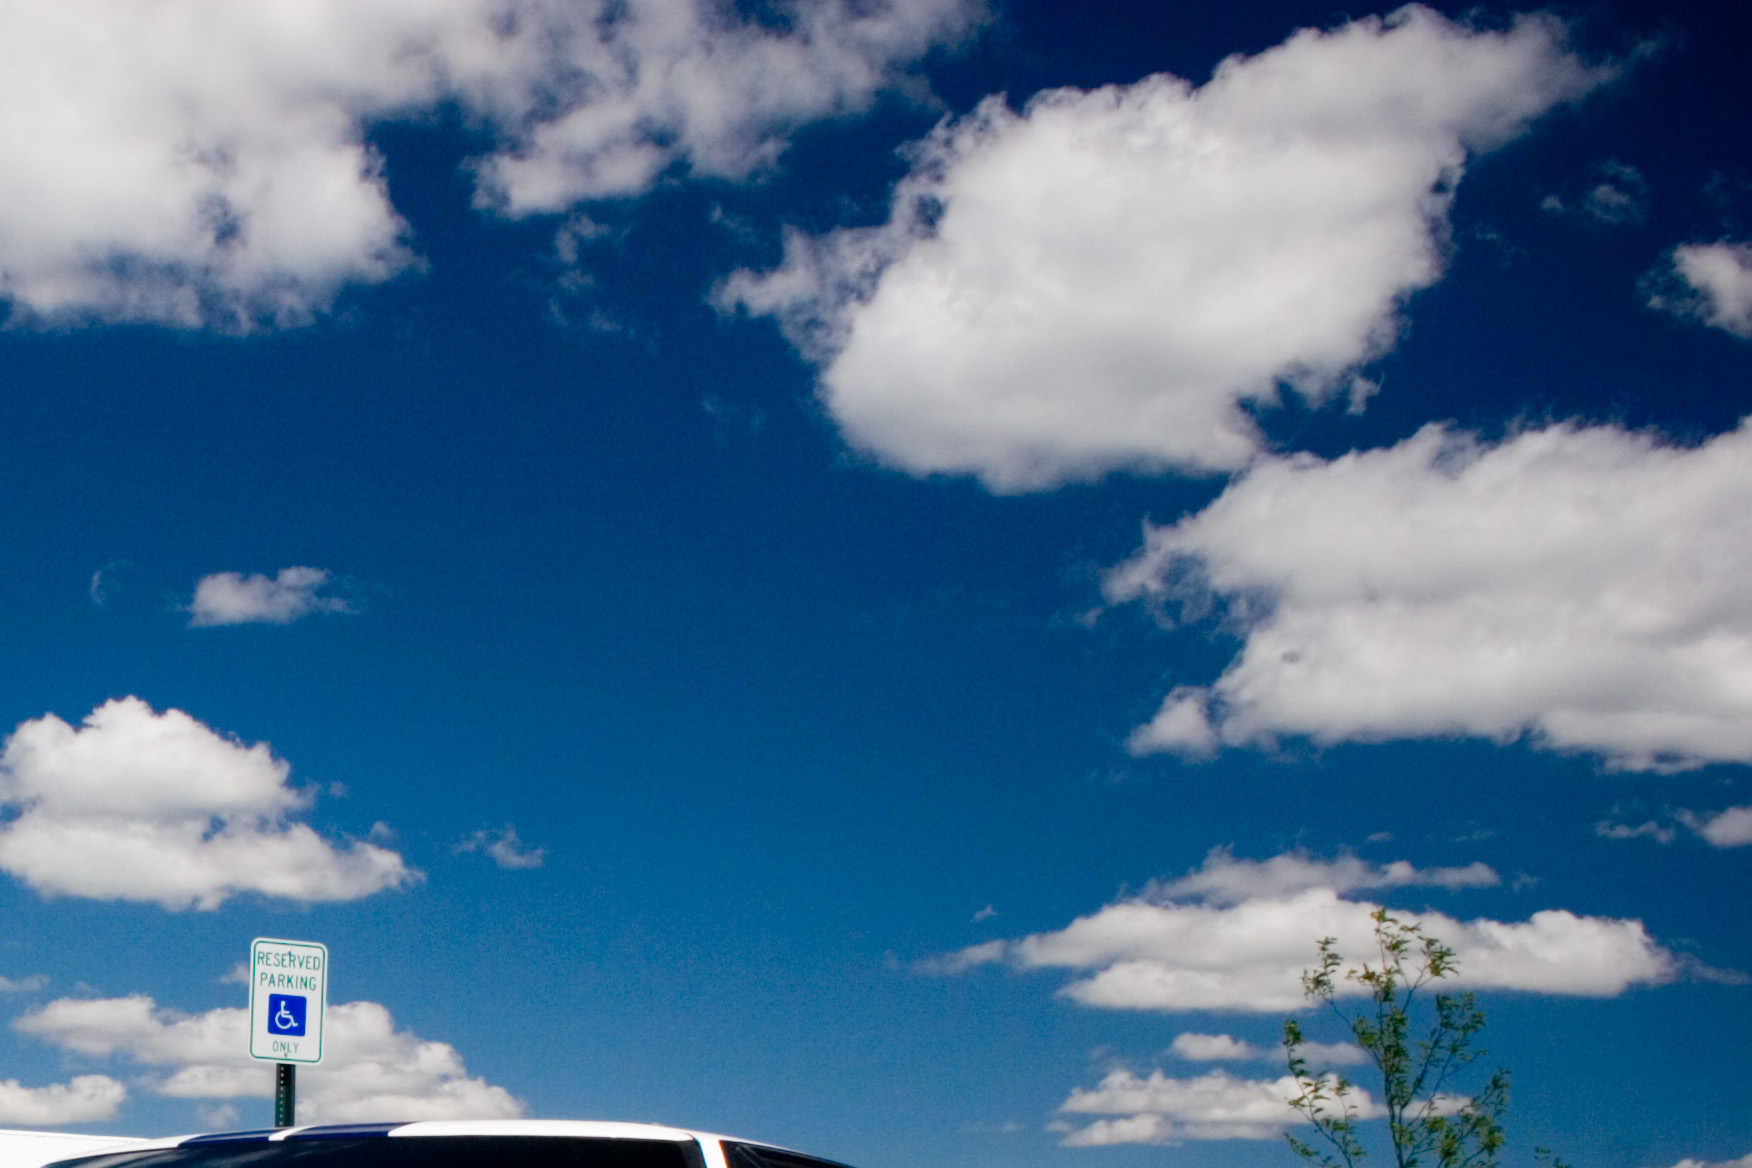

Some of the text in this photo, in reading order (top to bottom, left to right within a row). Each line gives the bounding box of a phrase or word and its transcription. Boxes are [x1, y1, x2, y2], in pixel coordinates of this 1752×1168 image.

[257, 951, 321, 971] RESERVED
[260, 972, 317, 991] PARKING
[272, 1040, 300, 1053] ONLY
